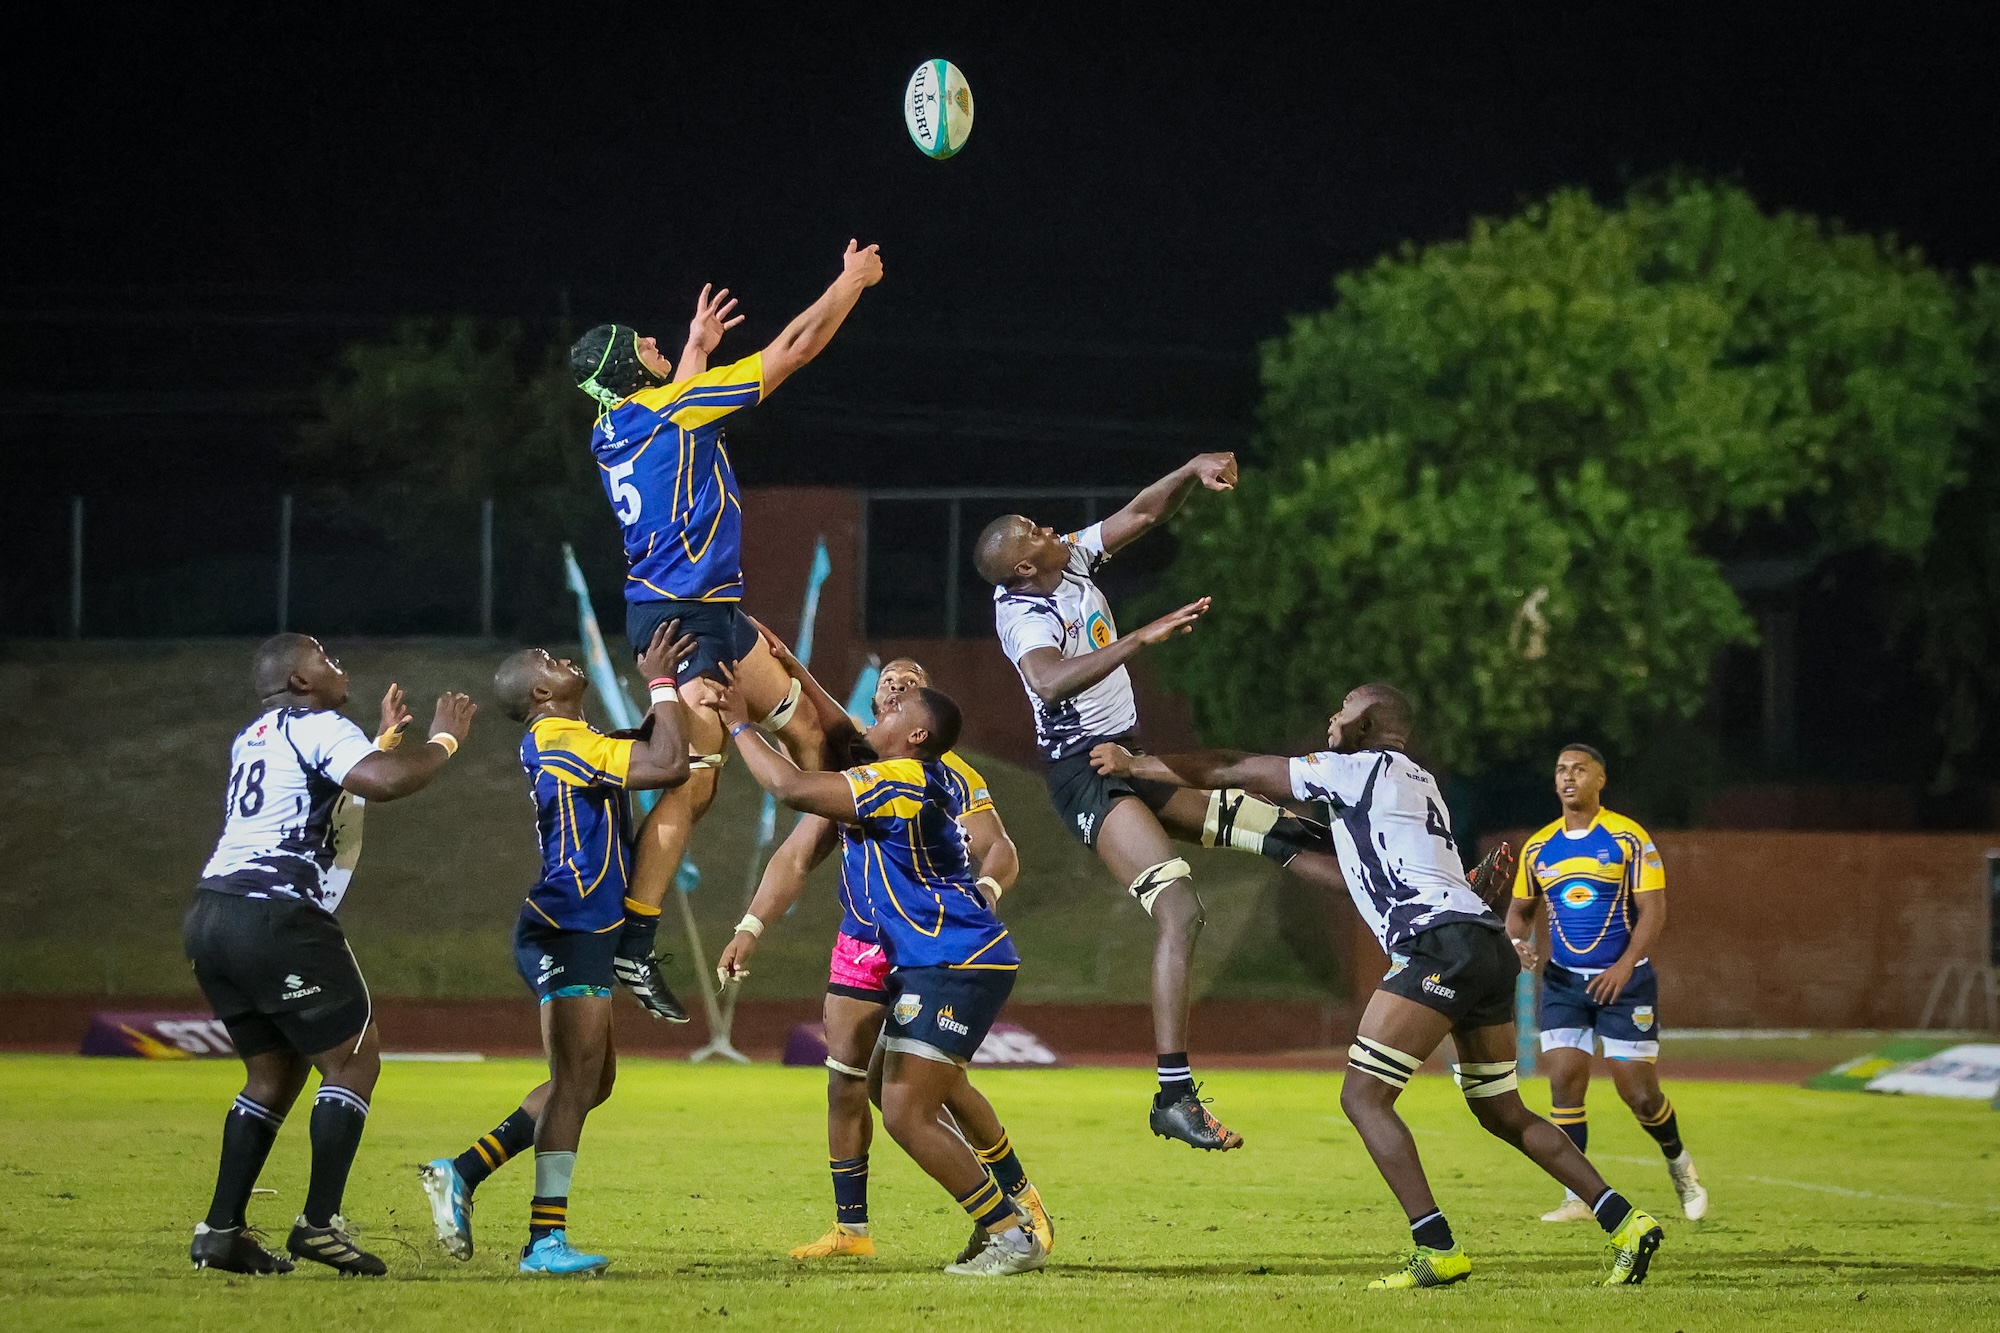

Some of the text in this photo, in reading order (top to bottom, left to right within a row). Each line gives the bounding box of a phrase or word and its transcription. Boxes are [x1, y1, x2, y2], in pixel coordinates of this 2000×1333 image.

[914, 66, 932, 140] GILBERT
[609, 461, 642, 526] 5
[227, 759, 266, 819] 18
[1425, 795, 1454, 851] 4
[1424, 981, 1456, 999] STEERS
[939, 1016, 969, 1036] STEERS
